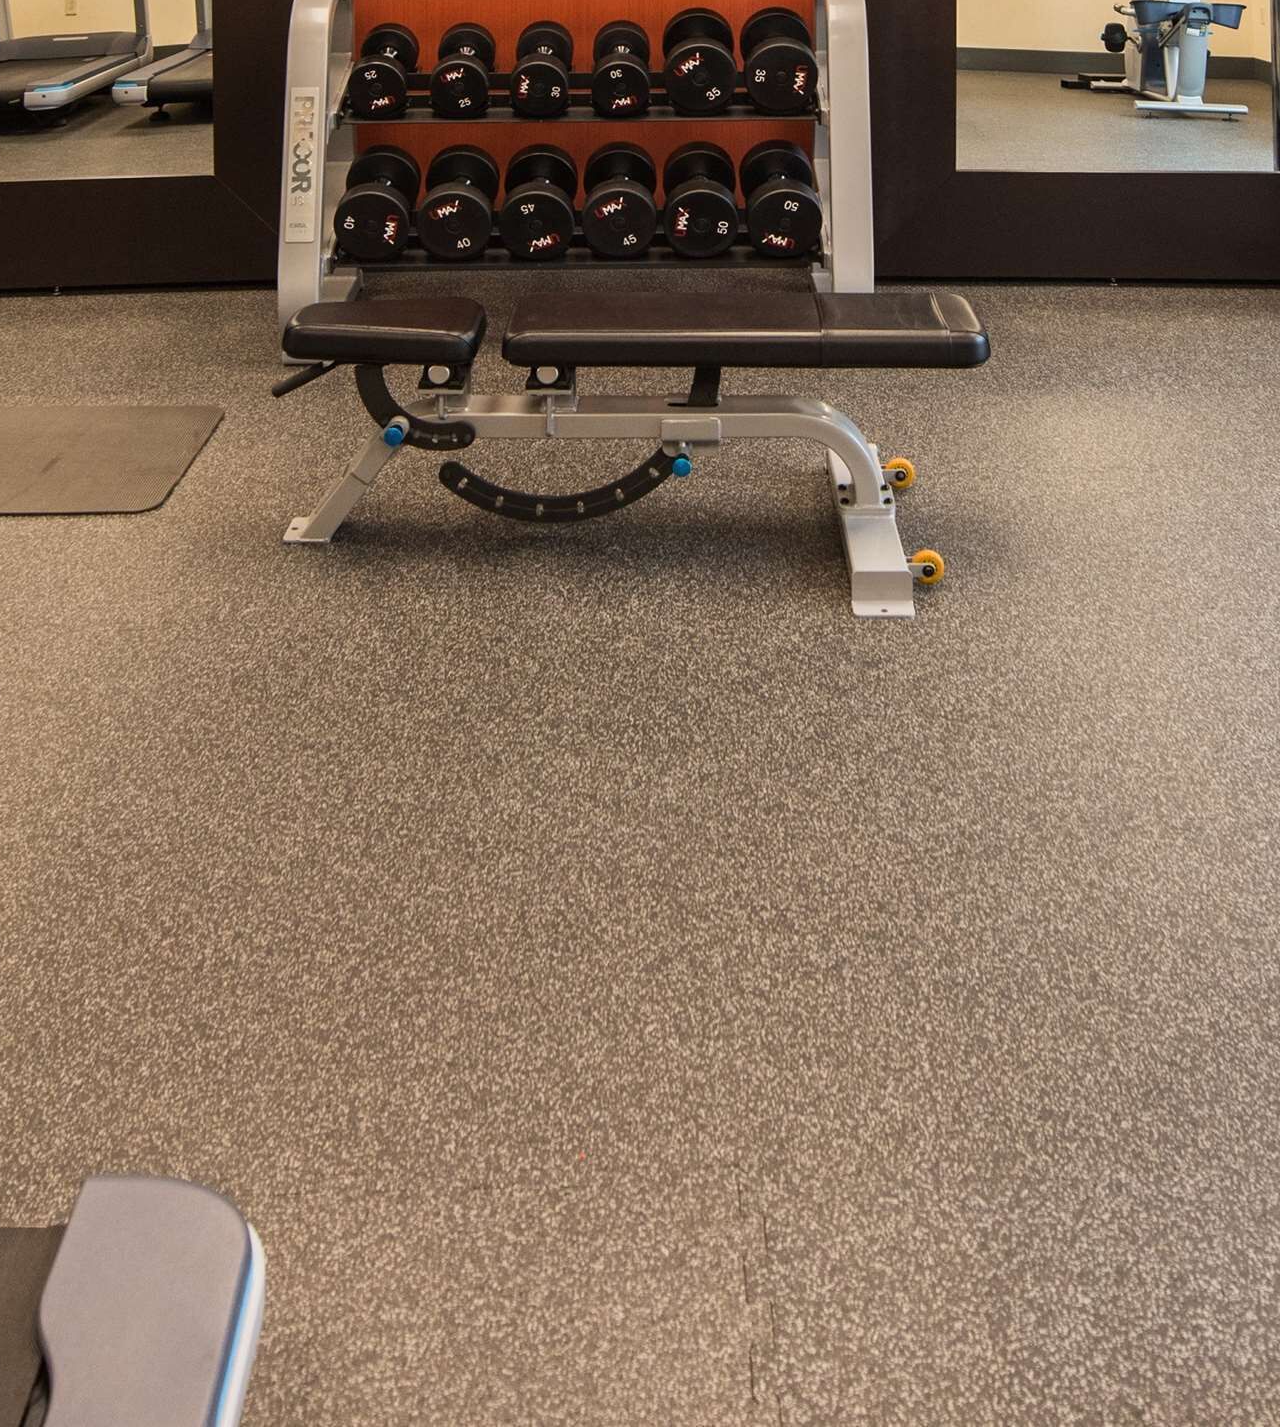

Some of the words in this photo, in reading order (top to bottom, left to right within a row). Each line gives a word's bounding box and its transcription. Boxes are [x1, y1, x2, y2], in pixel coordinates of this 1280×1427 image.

[364, 70, 377, 80] 25
[610, 69, 623, 79] 30
[754, 69, 766, 83] 35
[551, 86, 561, 98] 30
[706, 86, 721, 101] 35
[458, 97, 472, 108] 25
[520, 203, 535, 215] 45
[783, 200, 799, 212] 50
[343, 214, 355, 230] 40
[717, 220, 729, 235] 50
[456, 237, 471, 251] 40
[622, 233, 638, 247] 45
